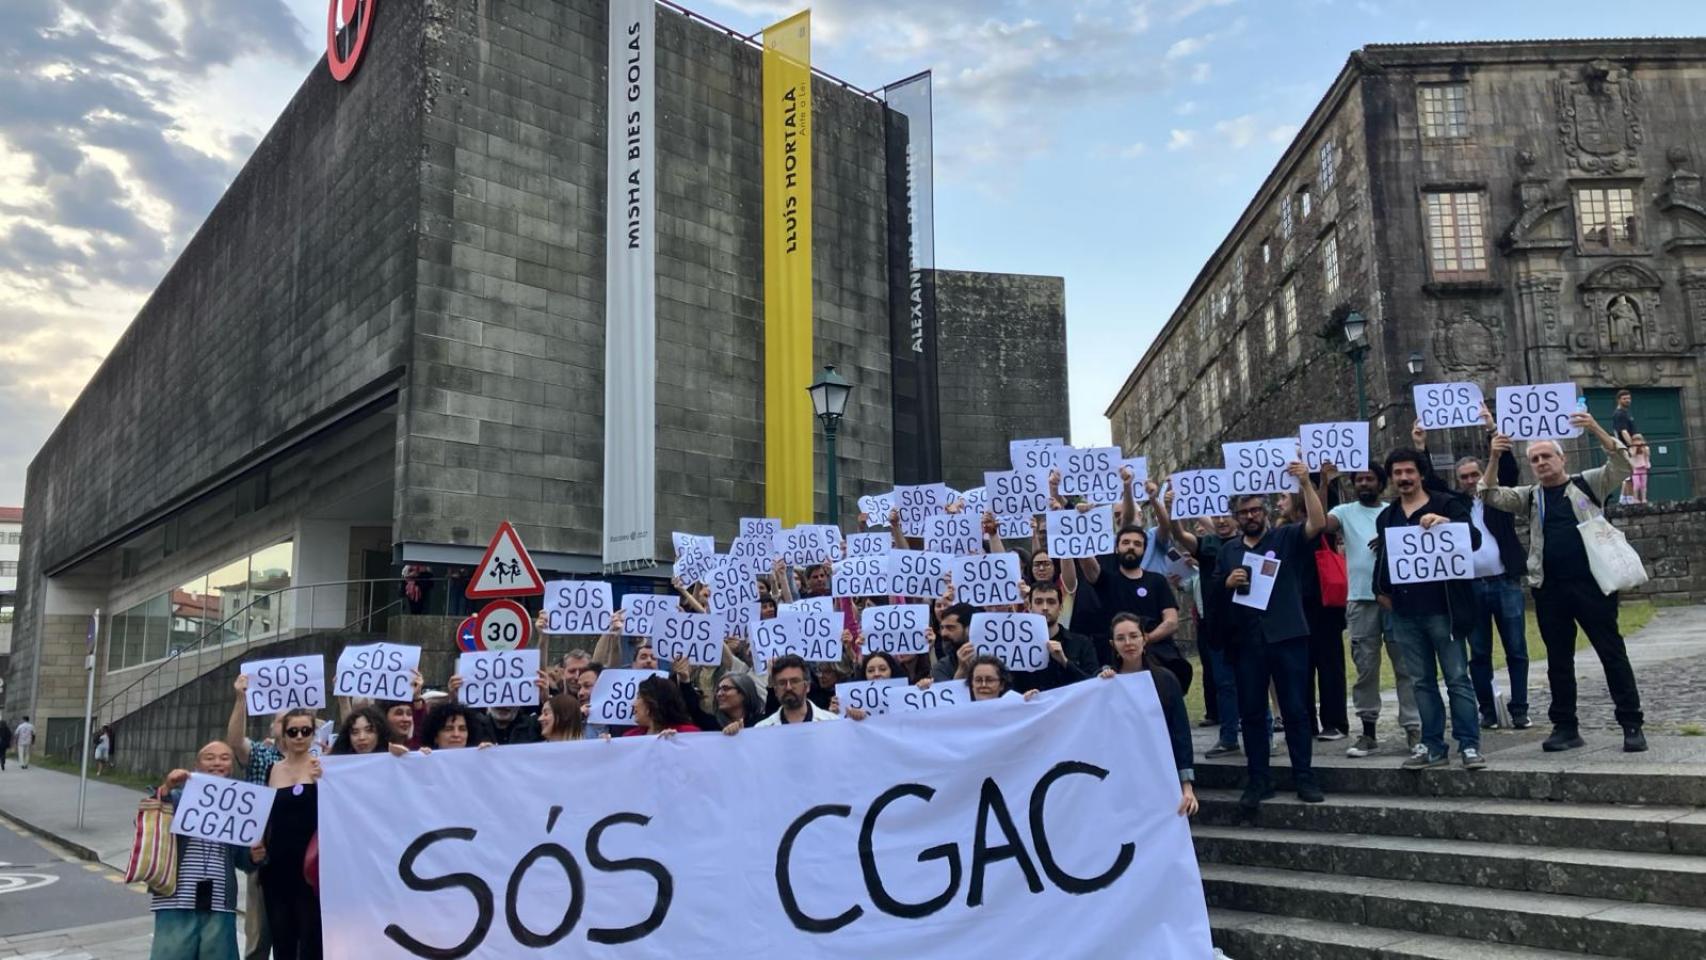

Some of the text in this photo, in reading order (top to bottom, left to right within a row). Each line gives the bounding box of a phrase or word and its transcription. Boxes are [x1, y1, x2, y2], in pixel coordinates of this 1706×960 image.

[628, 22, 640, 249] MISHA BIES GOLAS
[782, 87, 797, 254] LLUÍS HORTALÀ
[1427, 384, 1470, 408] SÓS
[1509, 386, 1559, 415] SÓS
[1422, 405, 1480, 427] CGAC
[1502, 413, 1571, 438] CGAC
[1311, 424, 1354, 449] SÓS
[1026, 446, 1056, 468] SÓ
[1068, 449, 1110, 474] SÓS
[1239, 443, 1286, 469] SÓS
[997, 471, 1037, 496] SÓS
[1063, 471, 1118, 493] CGAC
[1180, 471, 1220, 496] SÓS
[1233, 469, 1292, 492] CGAC
[902, 486, 936, 507] SÓS
[992, 493, 1047, 515] CGAC
[1176, 494, 1230, 517] CGAC
[935, 515, 970, 537] SÓS
[998, 519, 1030, 537] GAC
[788, 530, 818, 550] SÓS
[853, 533, 882, 554] SÓS
[1054, 533, 1110, 556] CGAC
[783, 548, 825, 565] CGAC
[843, 557, 880, 576] SÓS
[901, 552, 941, 576] SÓS
[963, 556, 1008, 582] SÓS
[1396, 554, 1466, 580] CGAC
[680, 556, 713, 586] CGAC
[558, 582, 604, 609] SÓS
[713, 580, 759, 610] CGAC
[837, 576, 887, 595] CGAC
[892, 575, 947, 597] CGAC
[958, 581, 1017, 604] CGAC
[549, 610, 611, 631] CGAC
[665, 615, 711, 641] SÓS
[801, 612, 830, 637] ÓS
[873, 606, 916, 631] SÓS
[984, 614, 1033, 643] SÓS
[487, 622, 518, 642] 30
[757, 622, 787, 648] ÓS
[867, 631, 925, 653] CGAC
[353, 643, 403, 672] SÓS
[657, 639, 716, 663] CGAC
[257, 660, 308, 688] SÓS
[474, 652, 524, 681] SÓS
[339, 671, 409, 698] CGAC
[465, 681, 532, 705] CGAC
[611, 677, 637, 700] SÓ
[252, 686, 319, 712] CGAC
[199, 782, 256, 815] SÓS
[180, 807, 257, 843] CGAC
[384, 760, 1136, 959] SÓS CGAC
